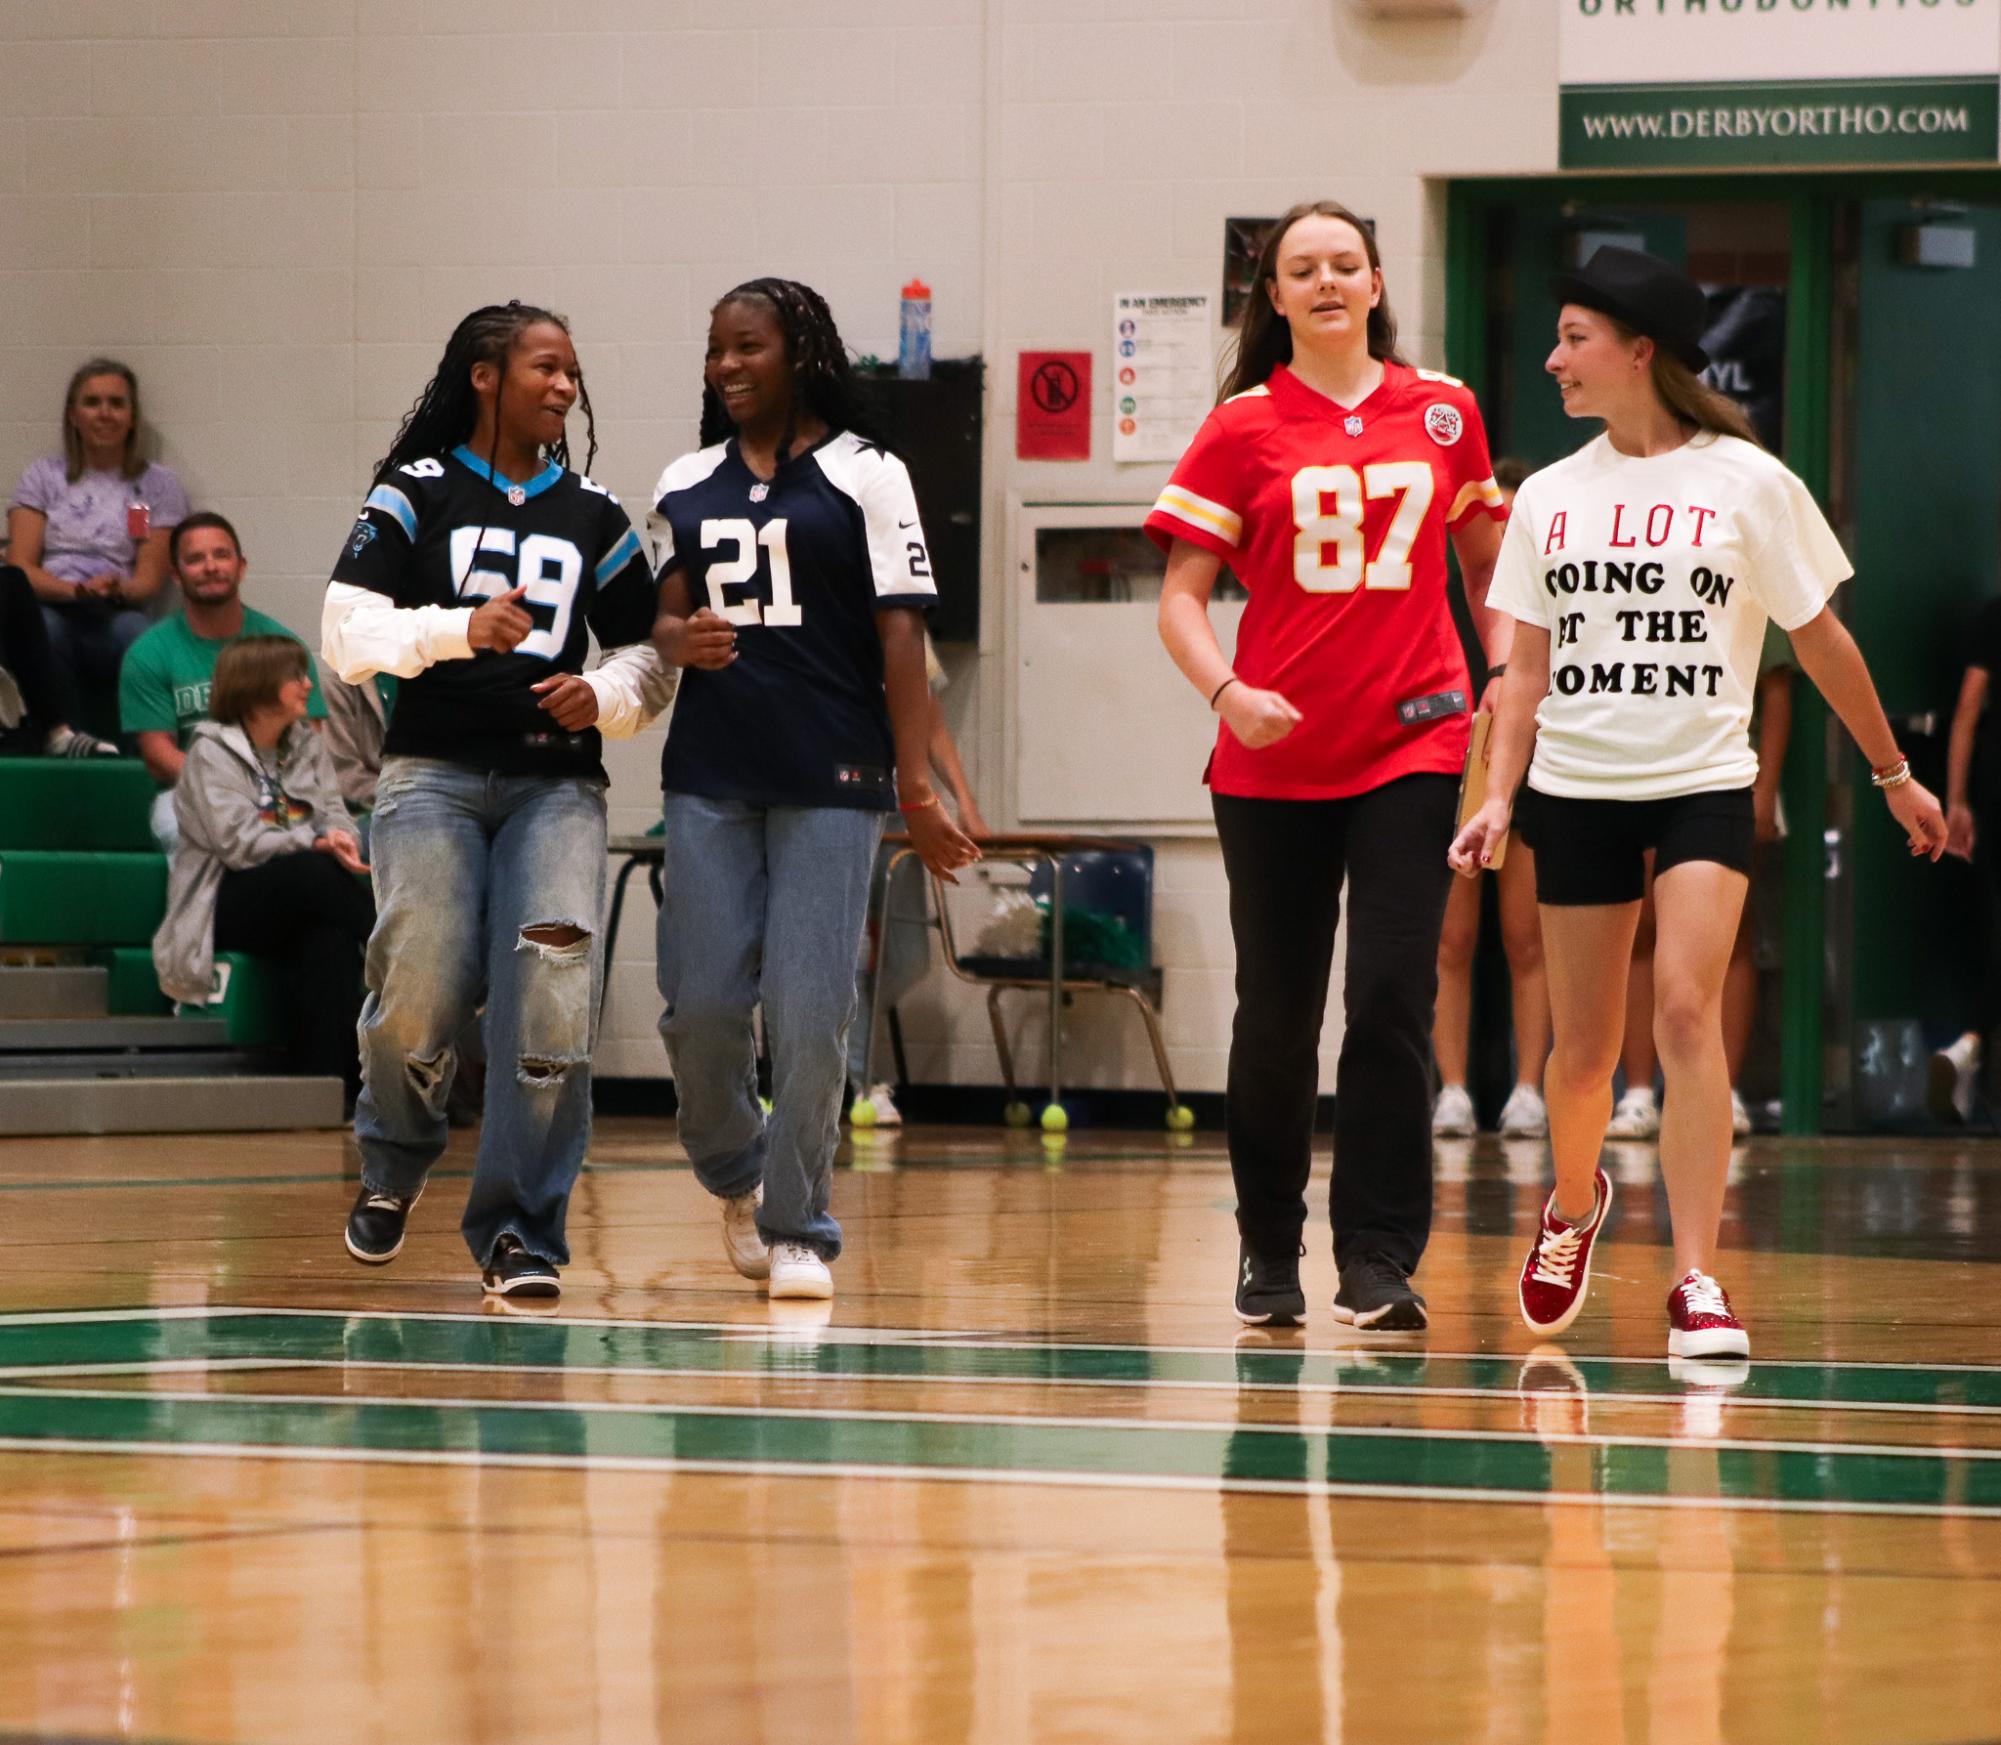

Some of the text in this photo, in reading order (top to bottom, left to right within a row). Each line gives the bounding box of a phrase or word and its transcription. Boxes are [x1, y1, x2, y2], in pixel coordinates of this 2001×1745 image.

[1583, 106, 1968, 138] WWW.DERBYORTHO.COM
[1291, 461, 1434, 593] 87
[1545, 504, 1716, 555] A LOT
[700, 518, 802, 627] 21
[907, 541, 931, 577] 2
[451, 525, 583, 662] 59
[1690, 567, 1734, 608] ON
[1616, 610, 1708, 643] THE
[1549, 662, 1724, 697] OMENT
